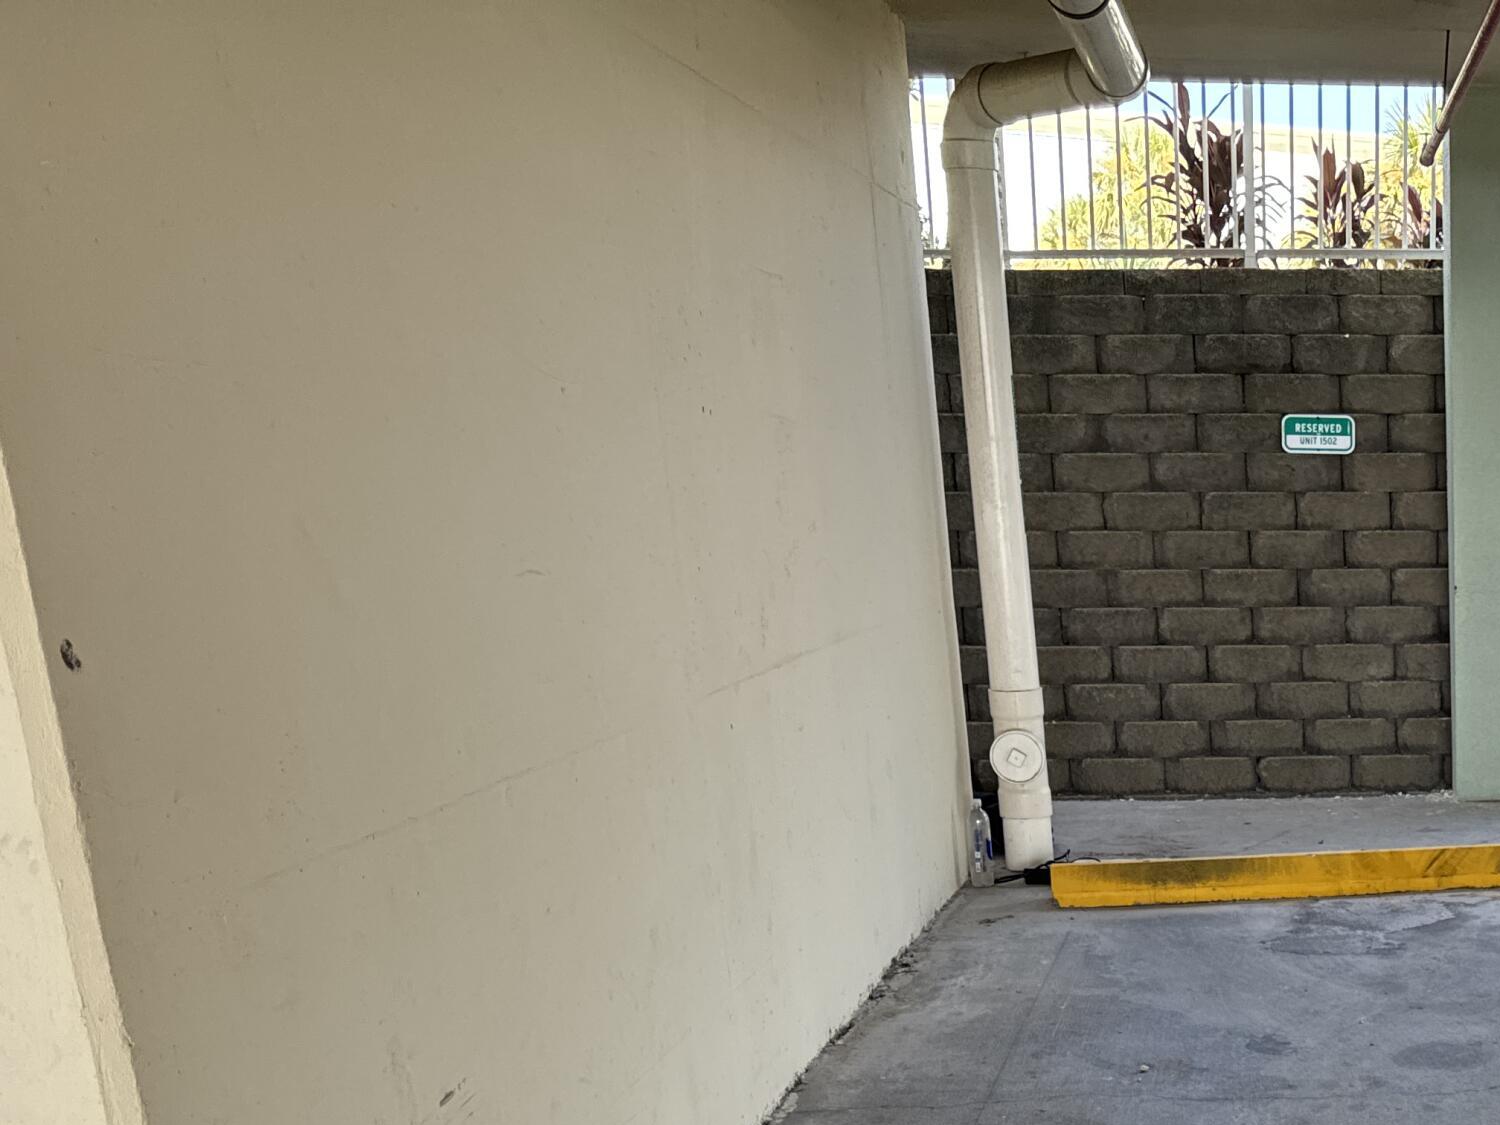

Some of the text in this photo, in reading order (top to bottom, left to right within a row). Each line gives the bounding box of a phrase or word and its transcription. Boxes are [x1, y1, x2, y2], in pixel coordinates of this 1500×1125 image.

[1295, 423, 1342, 433] RESERVED
[1300, 437, 1337, 445] UNIT 1502
